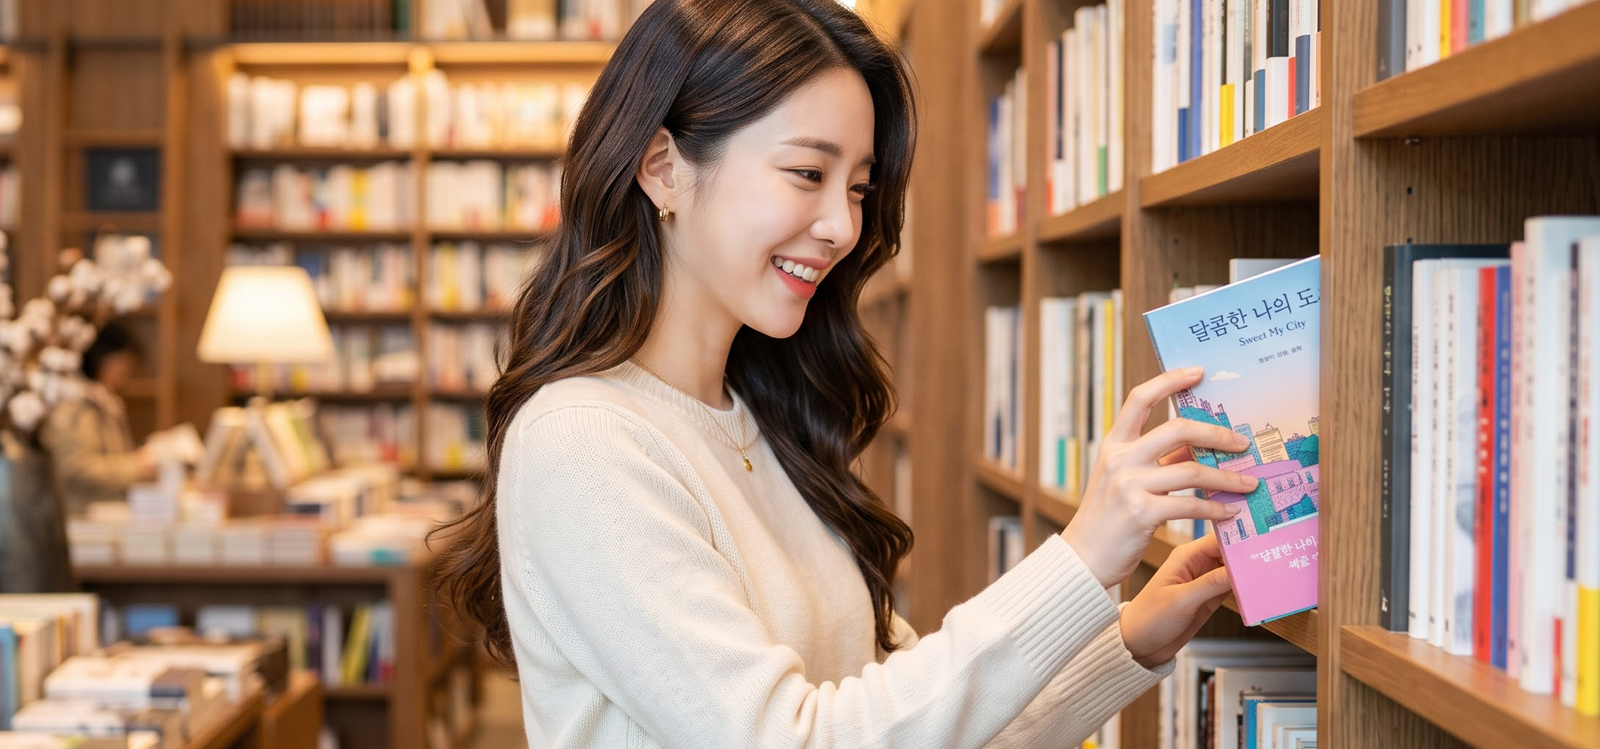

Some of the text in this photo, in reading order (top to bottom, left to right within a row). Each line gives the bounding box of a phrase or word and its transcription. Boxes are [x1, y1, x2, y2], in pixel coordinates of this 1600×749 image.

[1188, 287, 1321, 343] 달콤한 나의 도
[1238, 319, 1307, 347] Sweet My City
